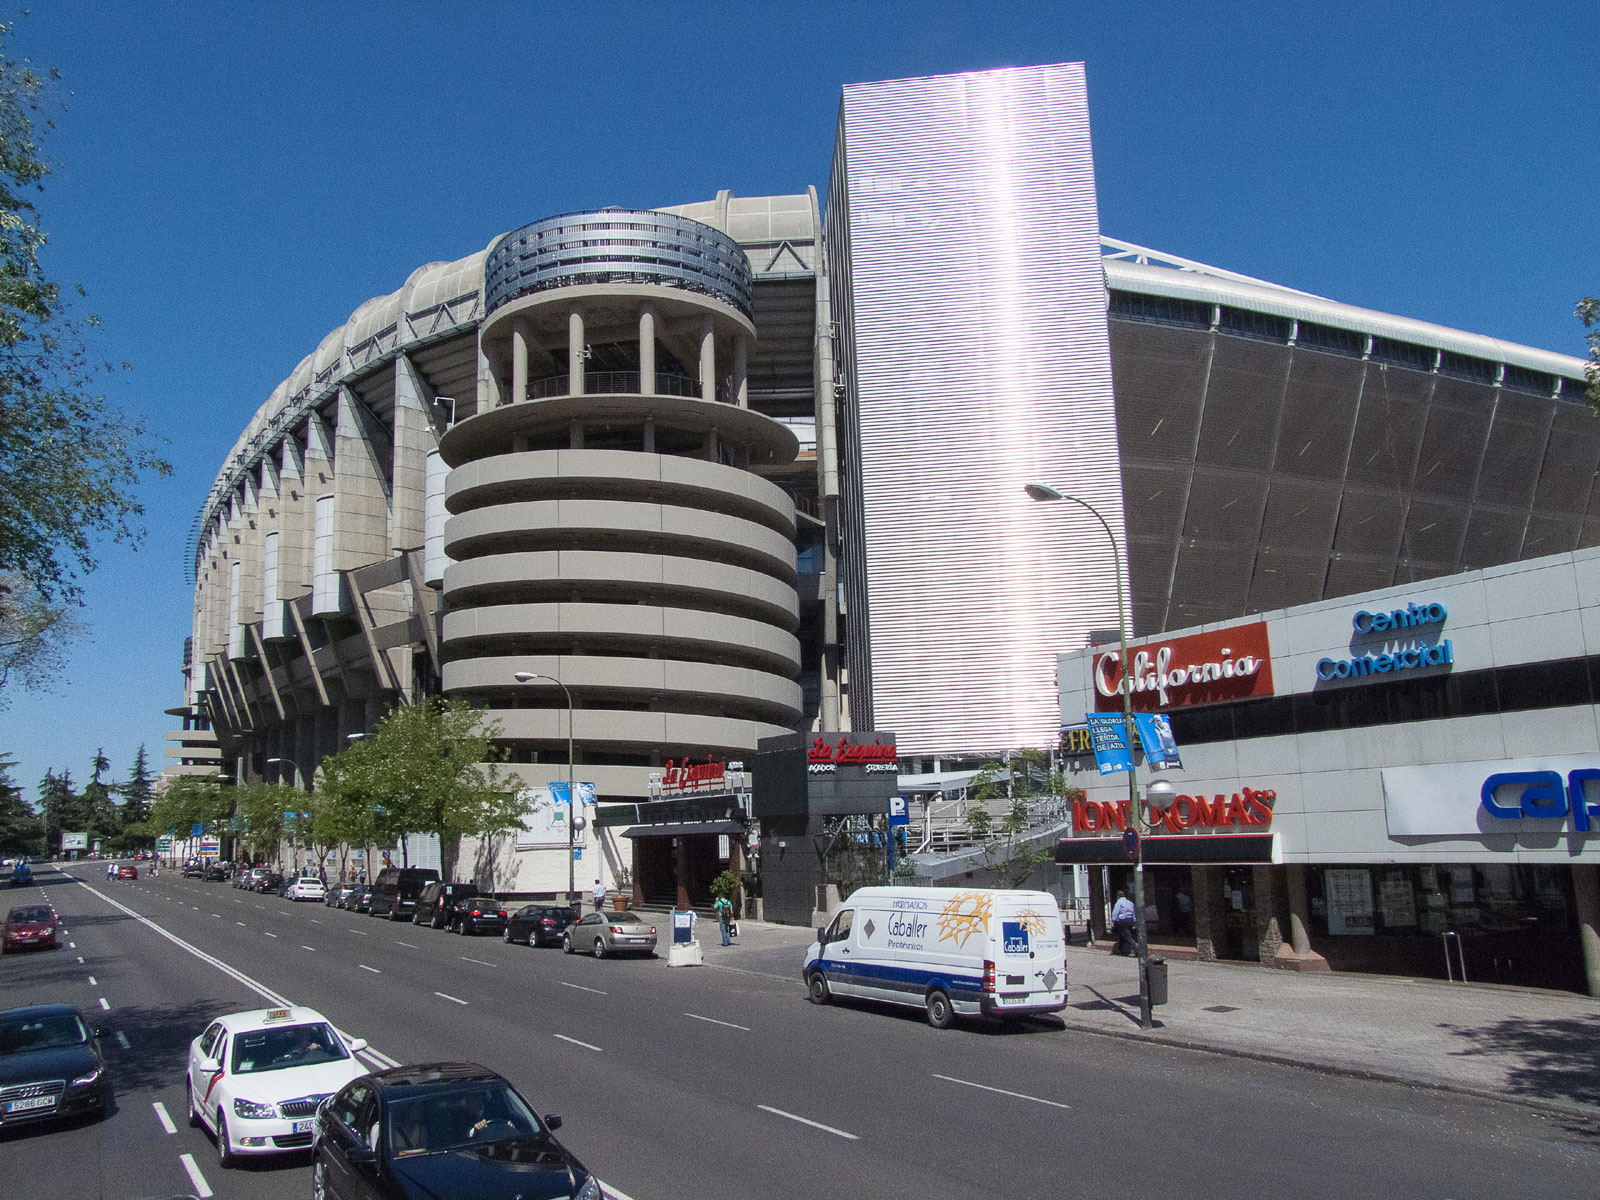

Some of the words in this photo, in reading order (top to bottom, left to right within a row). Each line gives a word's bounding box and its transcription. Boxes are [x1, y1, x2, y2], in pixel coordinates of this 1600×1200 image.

[1353, 602, 1447, 634] Centro
[1316, 639, 1454, 681] Comercial
[1095, 647, 1263, 706] California
[1092, 726, 1113, 734] LLEGA
[808, 737, 832, 757] La
[835, 737, 897, 763] Esquina
[1096, 744, 1108, 752] DE
[889, 797, 906, 817] P
[887, 912, 928, 939] Caballer
